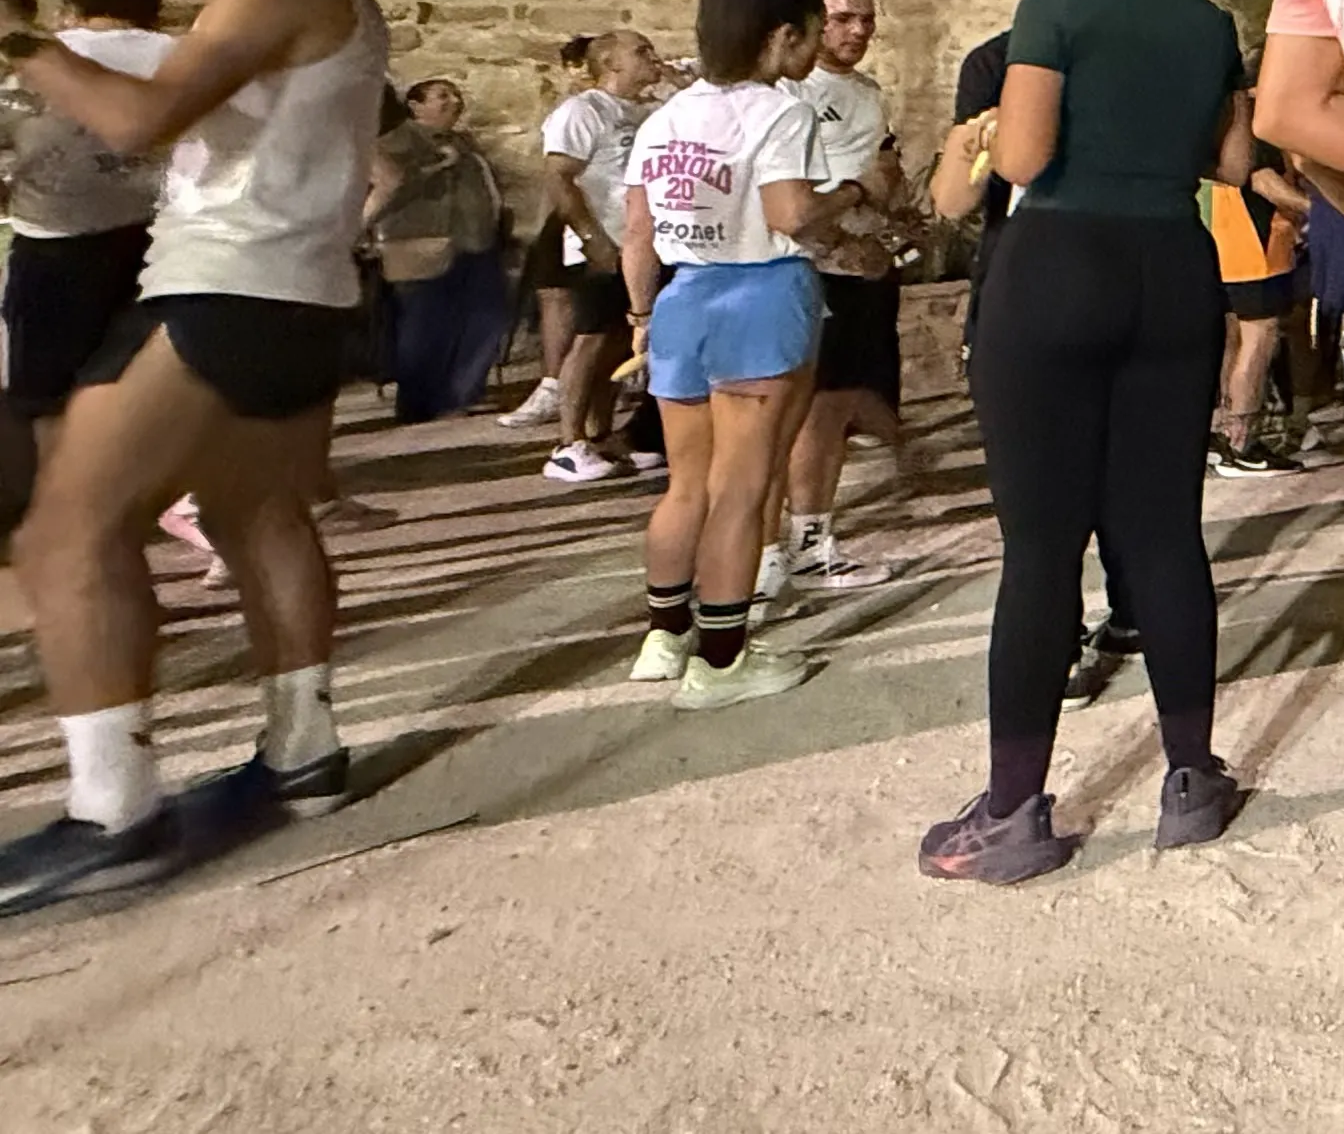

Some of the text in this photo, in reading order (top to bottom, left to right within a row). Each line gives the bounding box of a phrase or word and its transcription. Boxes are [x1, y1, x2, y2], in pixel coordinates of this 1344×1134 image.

[641, 154, 732, 195] ARNOLD
[664, 177, 695, 201] 20
[652, 216, 726, 241] eonet
